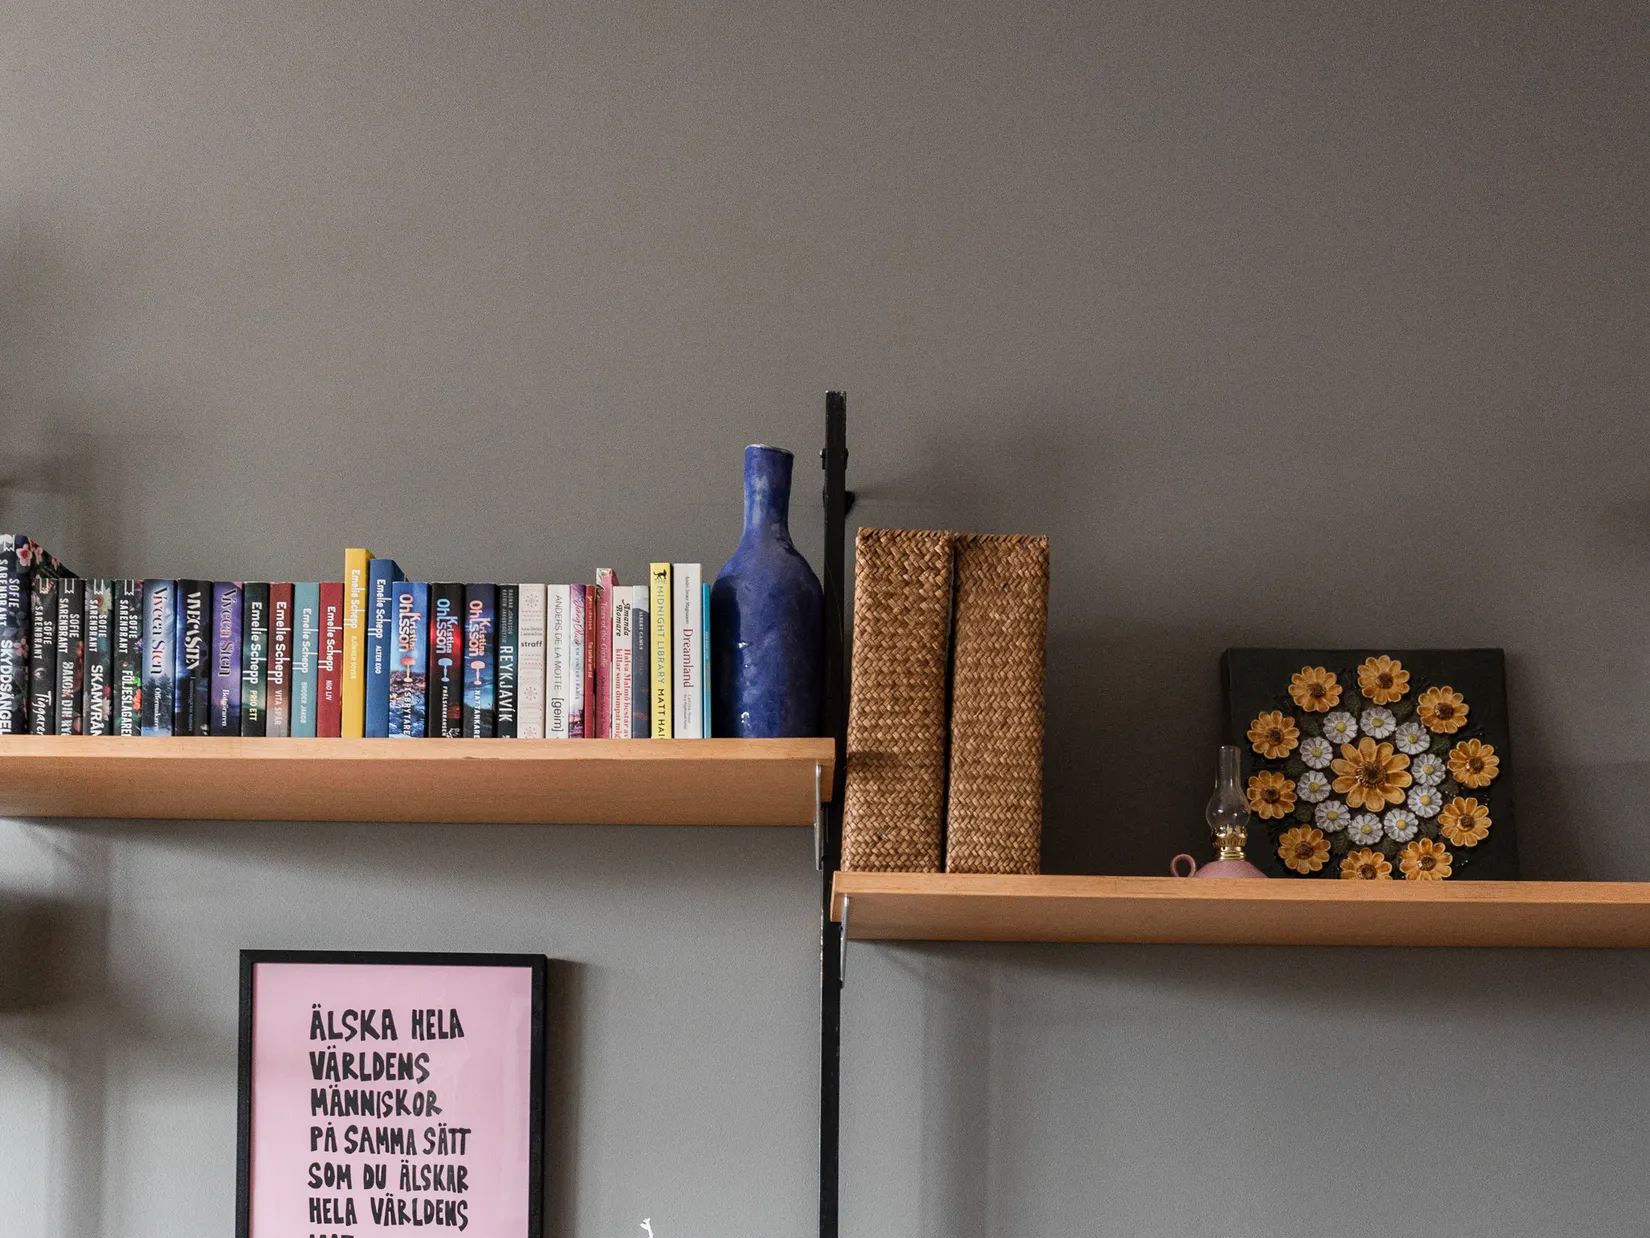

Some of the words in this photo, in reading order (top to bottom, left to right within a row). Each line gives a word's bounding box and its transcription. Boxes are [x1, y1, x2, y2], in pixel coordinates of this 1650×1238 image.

[8, 578, 20, 608] SOFIE
[351, 569, 365, 597] Emelie
[376, 579, 392, 607] Emelie
[58, 598, 68, 654] SARENBRANT
[69, 614, 80, 638] SOFIE
[88, 599, 98, 652] SARENBRANT
[98, 614, 107, 637] SOFIE
[119, 599, 128, 654] SARENBRANT
[128, 614, 138, 639] SOFIE
[152, 587, 168, 634] Viveca
[220, 589, 237, 637] Viveca
[251, 602, 267, 641] Emelie
[276, 601, 291, 641] Emelie
[302, 608, 318, 639] Emelie
[327, 606, 342, 637] Emelie
[344, 599, 365, 628] Schepp
[368, 609, 391, 638] Schepp
[399, 594, 413, 652] Ohlsson
[436, 598, 450, 653] Ohlsson
[469, 600, 483, 656] Ohlsson
[622, 599, 630, 636] Amanda
[656, 586, 665, 638] MIDNIGHT
[33, 606, 43, 659] SARENBRANT
[43, 621, 52, 645] SOFIE
[409, 612, 421, 652] Kristina
[446, 616, 458, 653] Kristina
[478, 617, 491, 656] Kristina
[555, 633, 562, 645] DE
[150, 640, 168, 674] Sten
[218, 641, 234, 677] Sten
[243, 644, 266, 684] Schepp
[268, 644, 290, 684] Schepp
[292, 641, 318, 673] Schepp
[318, 639, 342, 671] Schepp
[554, 647, 562, 658] LA
[657, 641, 665, 684] LIBRARY
[682, 628, 694, 688] Dreamland
[62, 662, 74, 698] BAKOM
[498, 646, 515, 722] REYKJAVÍK
[61, 700, 73, 718] DIN
[121, 670, 134, 736] FÖLJESLAGARE
[220, 689, 229, 726] Botgöraren
[274, 707, 282, 725] SPÅR
[613, 690, 622, 722] dumpat
[657, 689, 666, 716] MATT
[310, 1004, 398, 1041] ÄLSKA
[411, 1008, 465, 1041] HELA
[309, 1045, 430, 1084] VÄRLDENS
[310, 1083, 443, 1119] MÄNNISKOR
[310, 1122, 338, 1153] PÅ
[344, 1126, 417, 1156] SAMMA
[423, 1122, 471, 1156] SÄTT
[308, 1162, 352, 1190] SOM
[363, 1163, 387, 1189] DU
[399, 1159, 469, 1193] ÄLSKAR
[309, 1197, 357, 1225] HELA
[370, 1193, 468, 1231] VÄRLDENS
